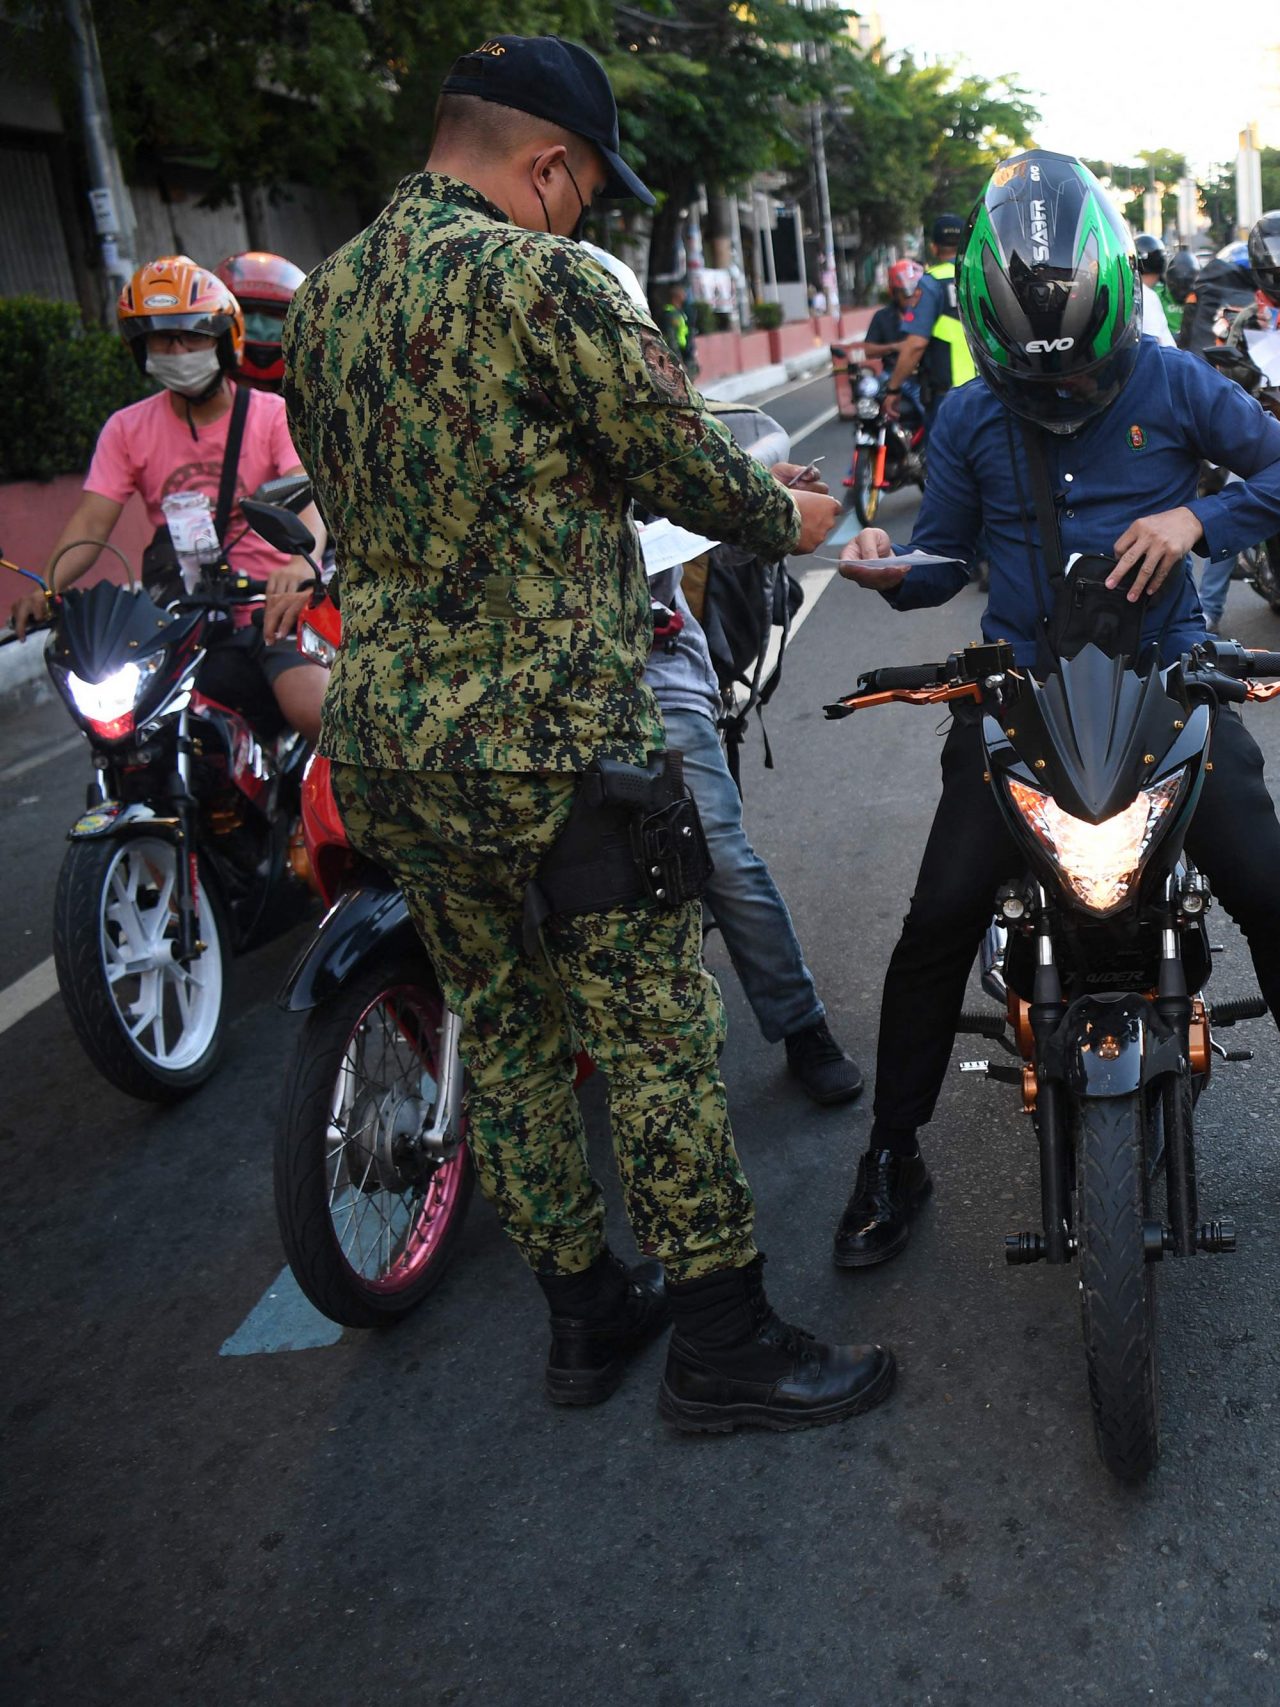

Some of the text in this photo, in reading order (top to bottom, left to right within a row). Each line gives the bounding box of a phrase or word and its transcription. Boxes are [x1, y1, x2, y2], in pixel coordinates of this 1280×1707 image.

[1030, 165, 1041, 182] EVO
[1030, 200, 1050, 262] SABER
[1025, 337, 1075, 353] EVO
